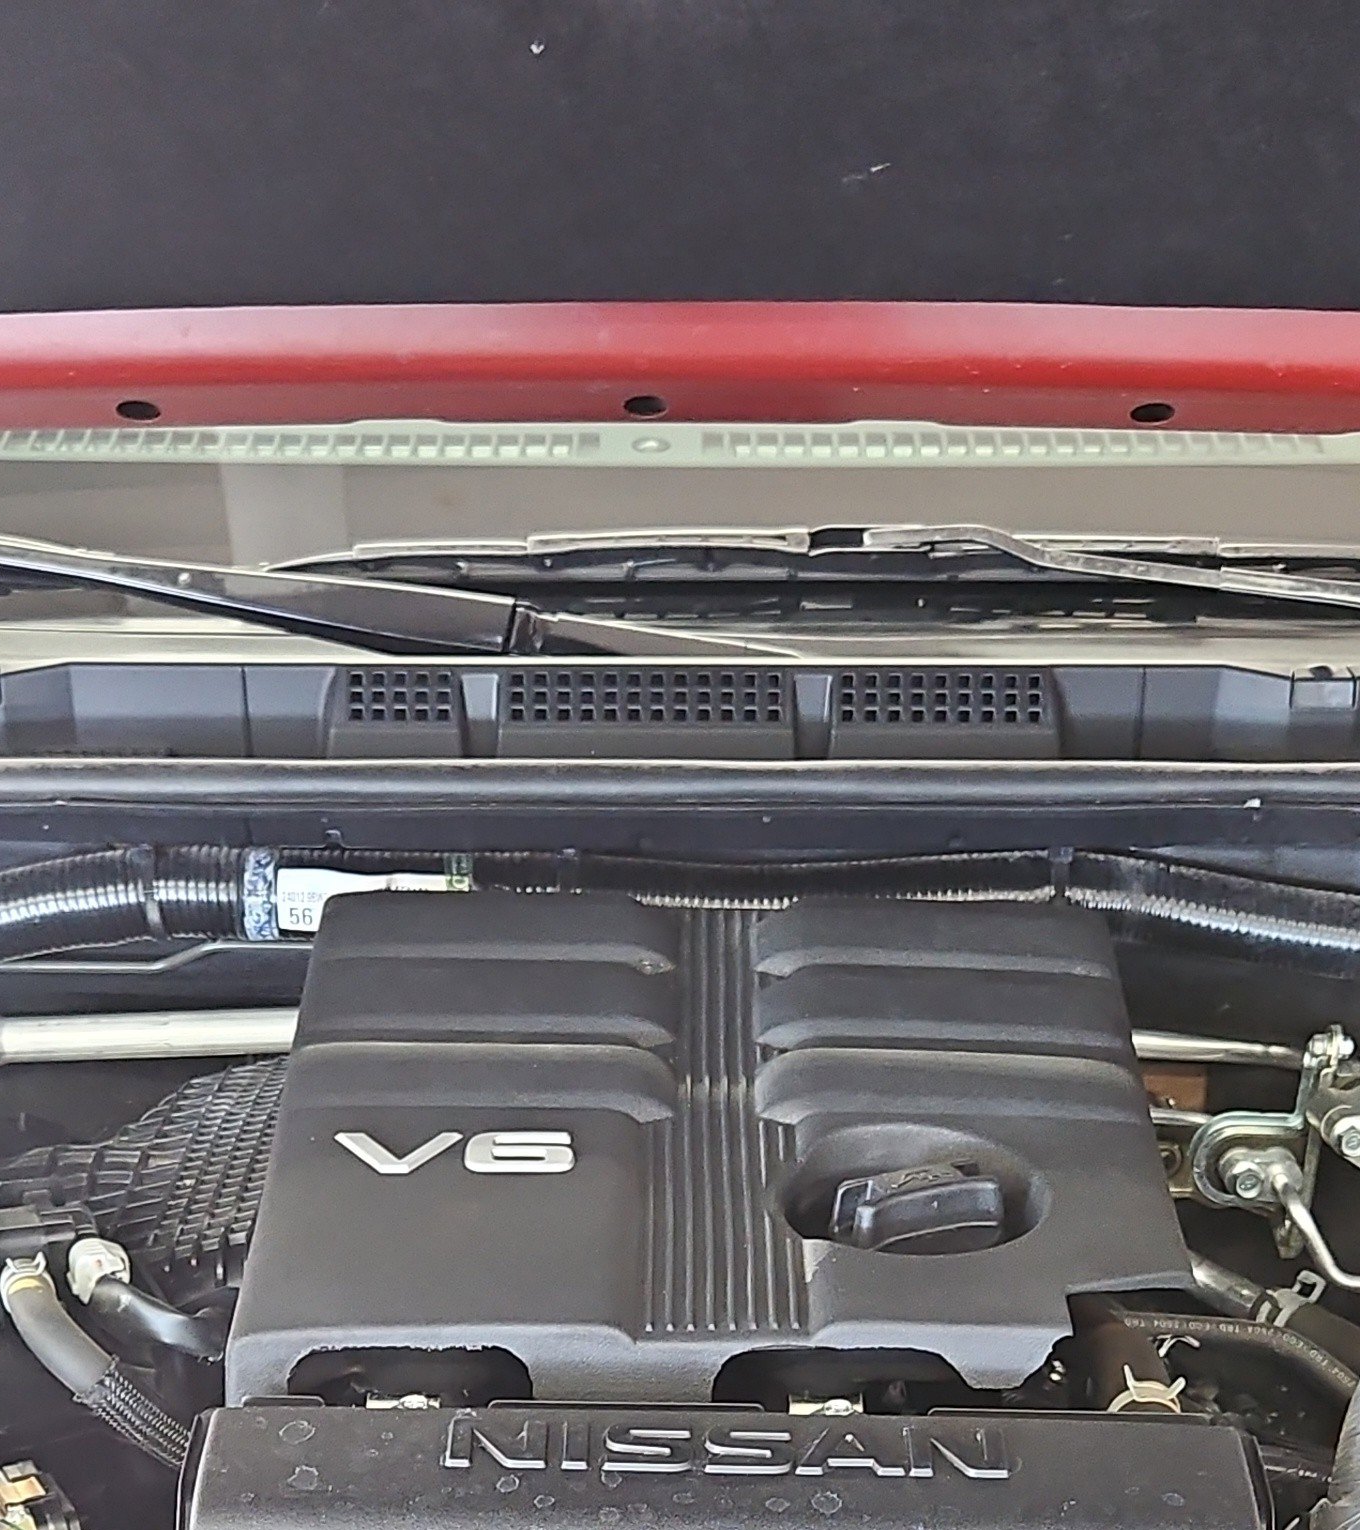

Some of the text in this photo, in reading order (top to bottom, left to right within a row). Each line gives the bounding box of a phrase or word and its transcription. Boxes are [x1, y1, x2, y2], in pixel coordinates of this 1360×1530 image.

[289, 907, 313, 926] 56
[333, 1131, 576, 1174] V6
[443, 1413, 1012, 1479] NISSAN
